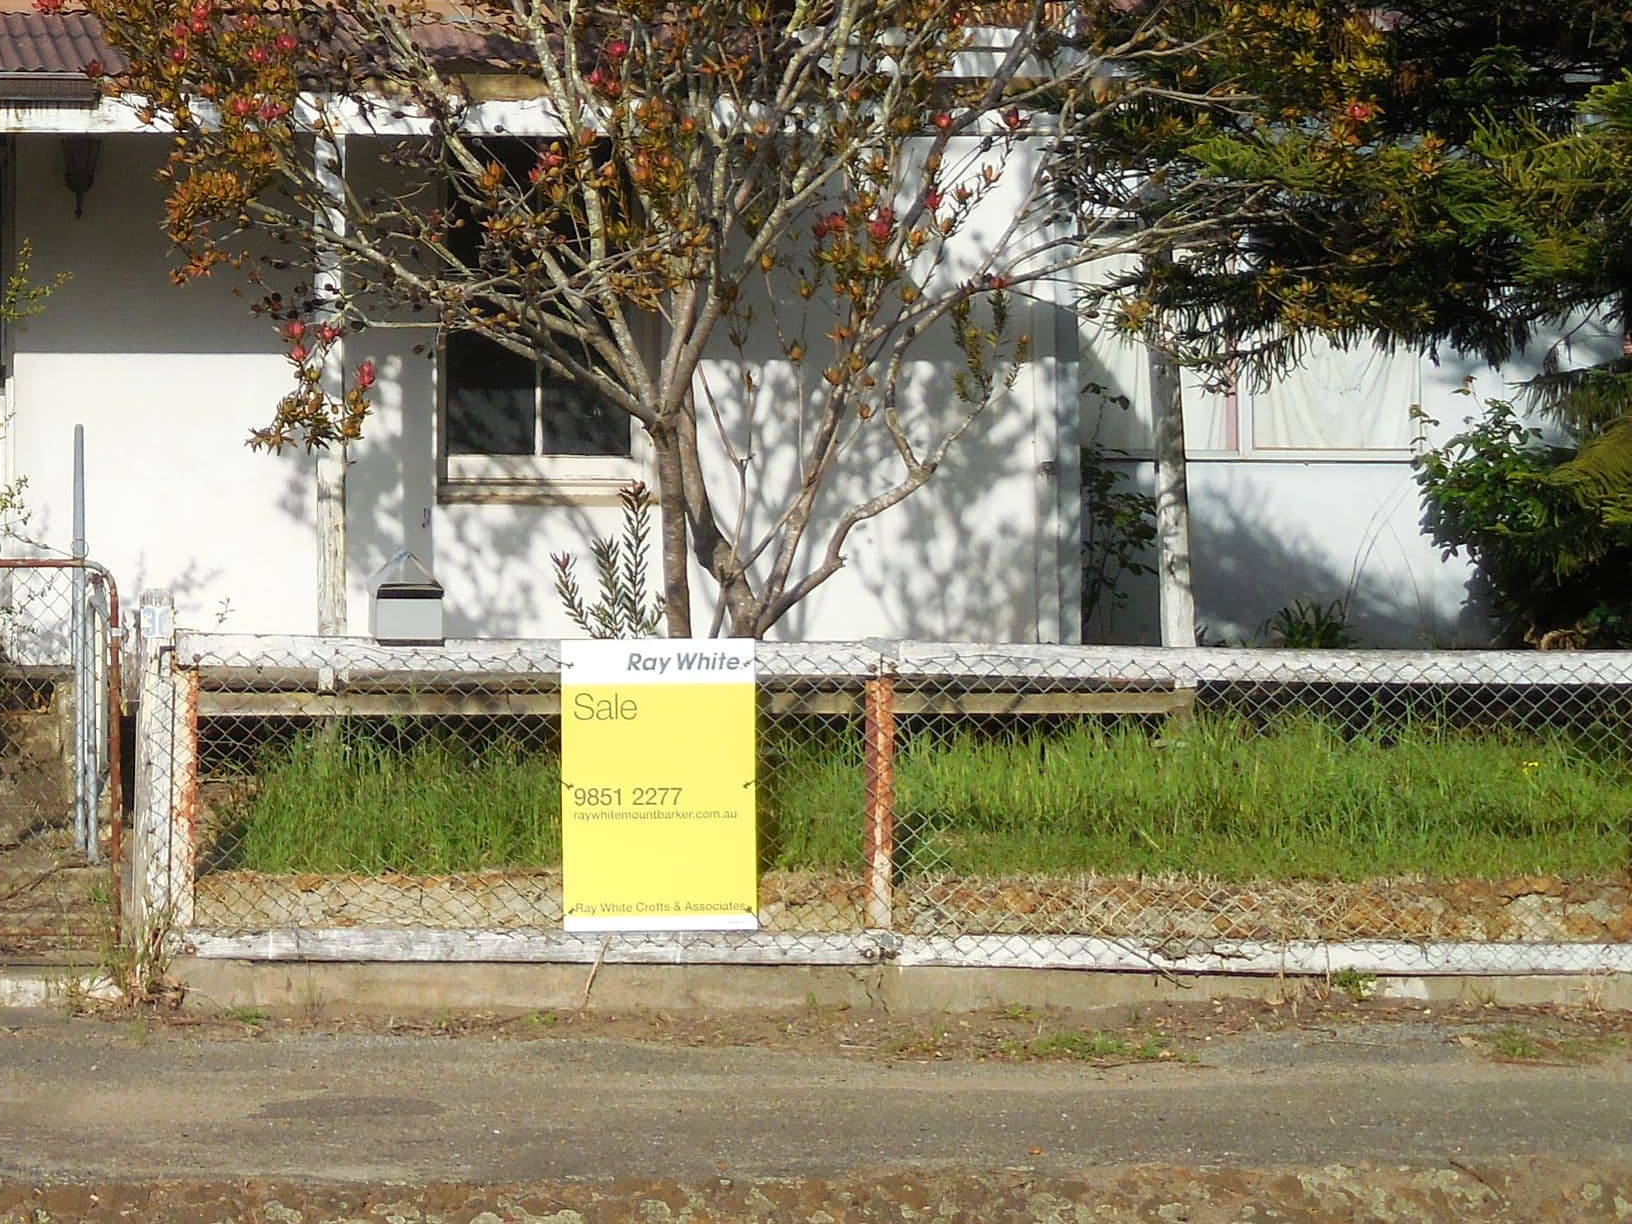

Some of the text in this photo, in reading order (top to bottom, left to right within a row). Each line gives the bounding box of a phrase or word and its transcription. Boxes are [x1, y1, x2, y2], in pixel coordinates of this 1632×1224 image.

[627, 653, 671, 674] Ray
[574, 692, 637, 721] Sale
[574, 787, 683, 806] 9851 2277
[574, 809, 737, 821] raywhitemountbarker.com.au
[575, 903, 597, 915] Ray
[601, 902, 632, 913] White
[674, 902, 681, 912] &
[685, 900, 746, 911] Associates
